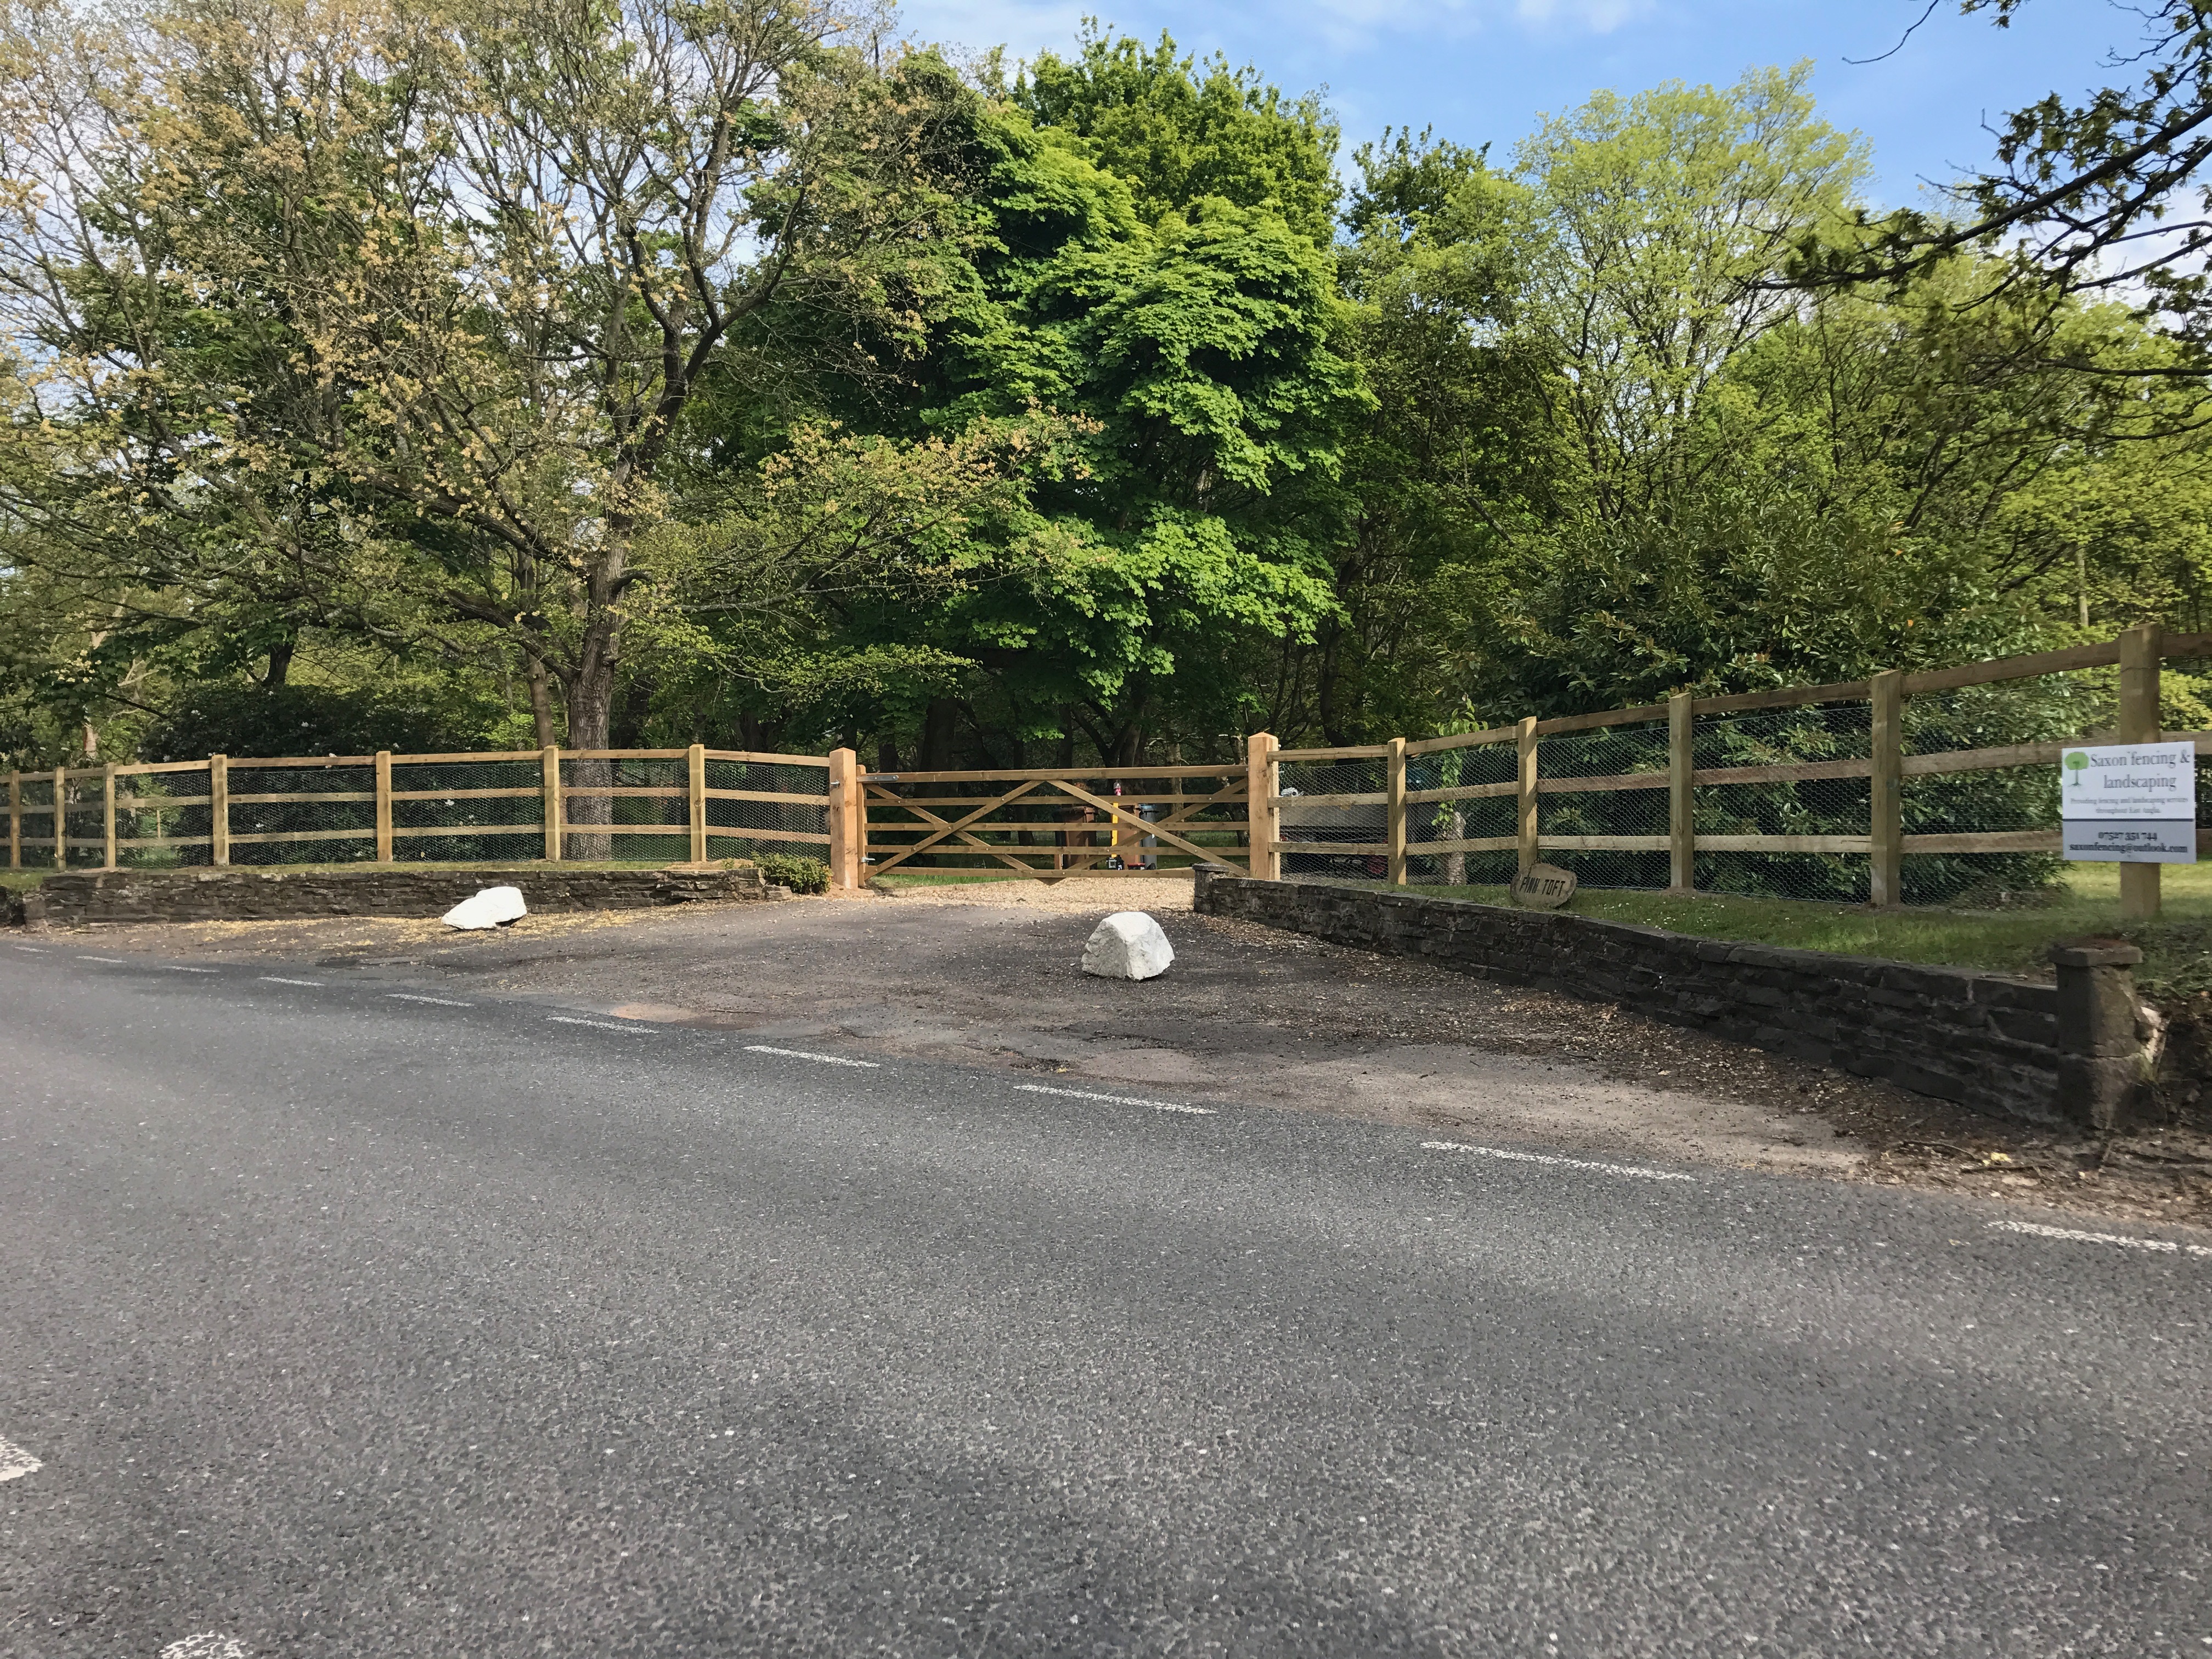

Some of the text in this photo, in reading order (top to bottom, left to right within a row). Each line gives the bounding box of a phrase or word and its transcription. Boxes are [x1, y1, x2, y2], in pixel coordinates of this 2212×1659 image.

[2091, 749, 2191, 769] Saxon fencing &
[2104, 774, 2177, 792] landscaping
[1541, 879, 1566, 897] TOFT
